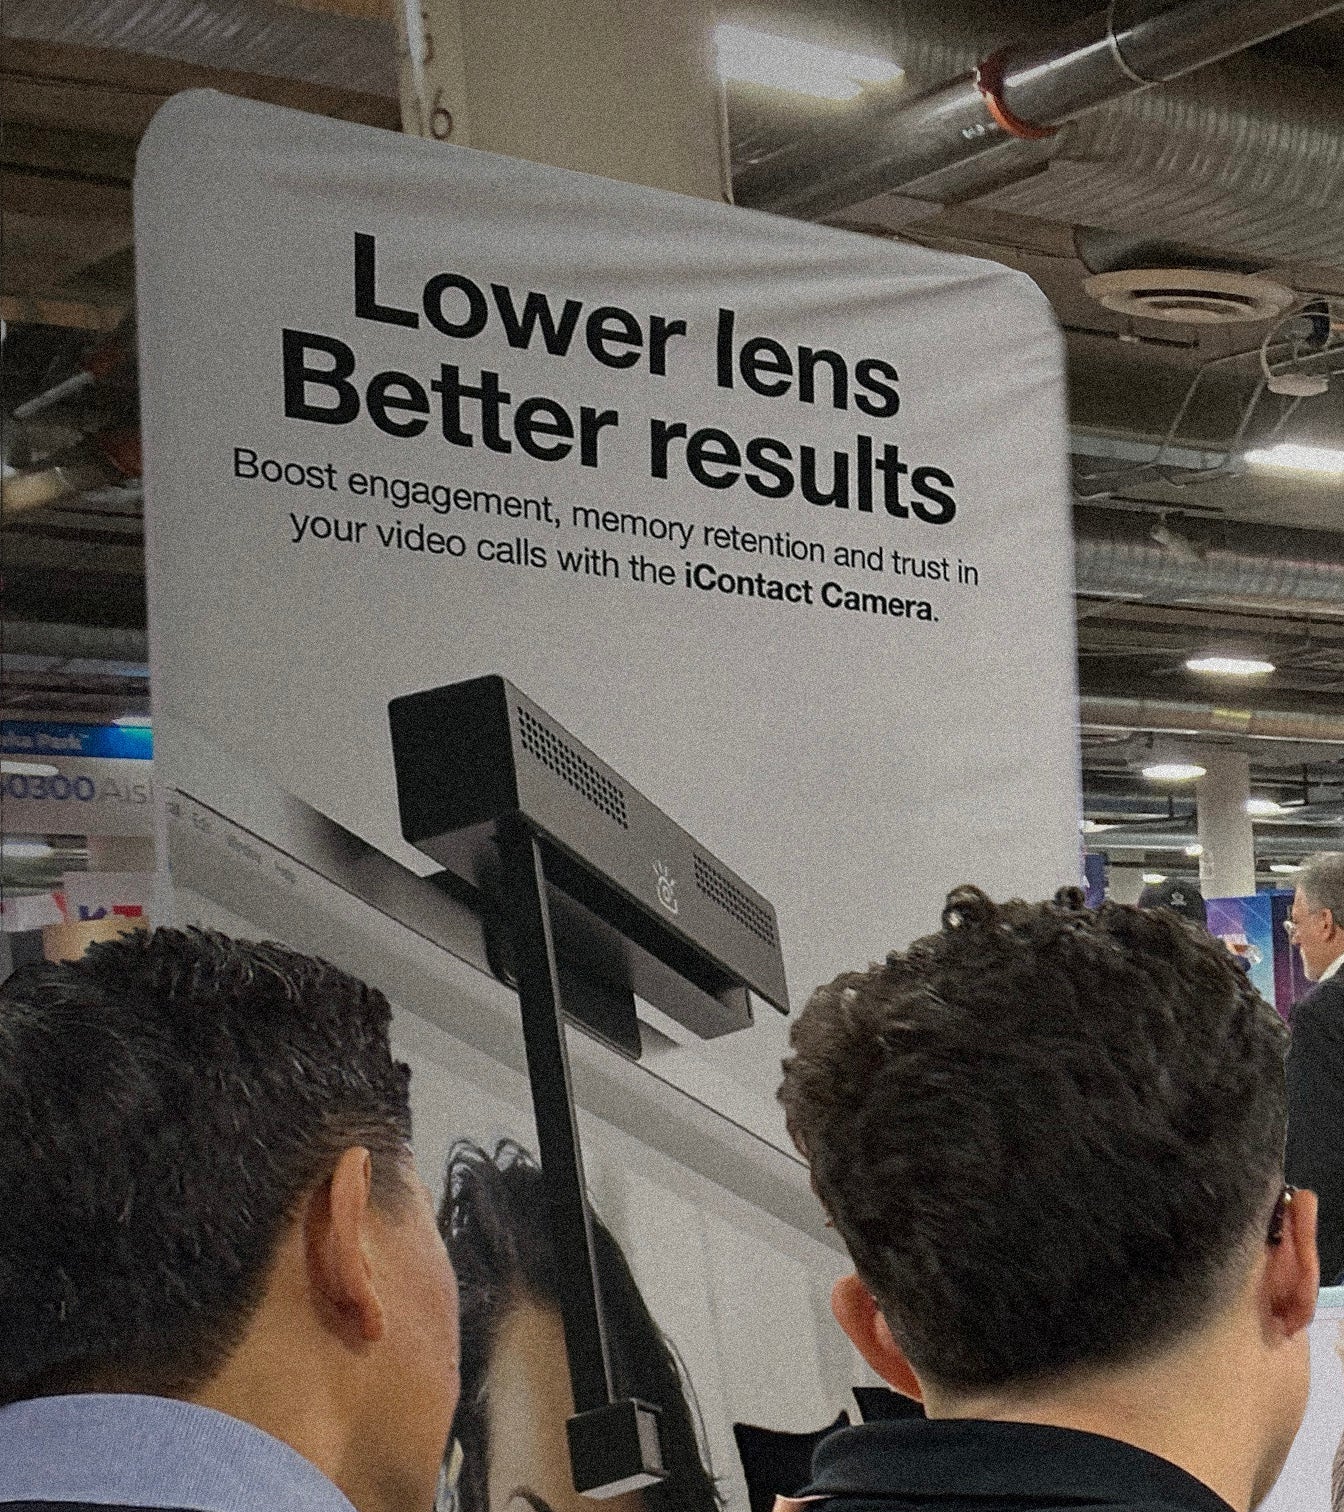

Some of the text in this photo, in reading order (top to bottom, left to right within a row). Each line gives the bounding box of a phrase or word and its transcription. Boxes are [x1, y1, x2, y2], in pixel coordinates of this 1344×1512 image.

[353, 232, 901, 418] Lower lens
[281, 328, 957, 525] Better results
[233, 447, 979, 586] Boost engagement, memory retention and trust in
[290, 512, 940, 624] your video calls with the iContact Camera.
